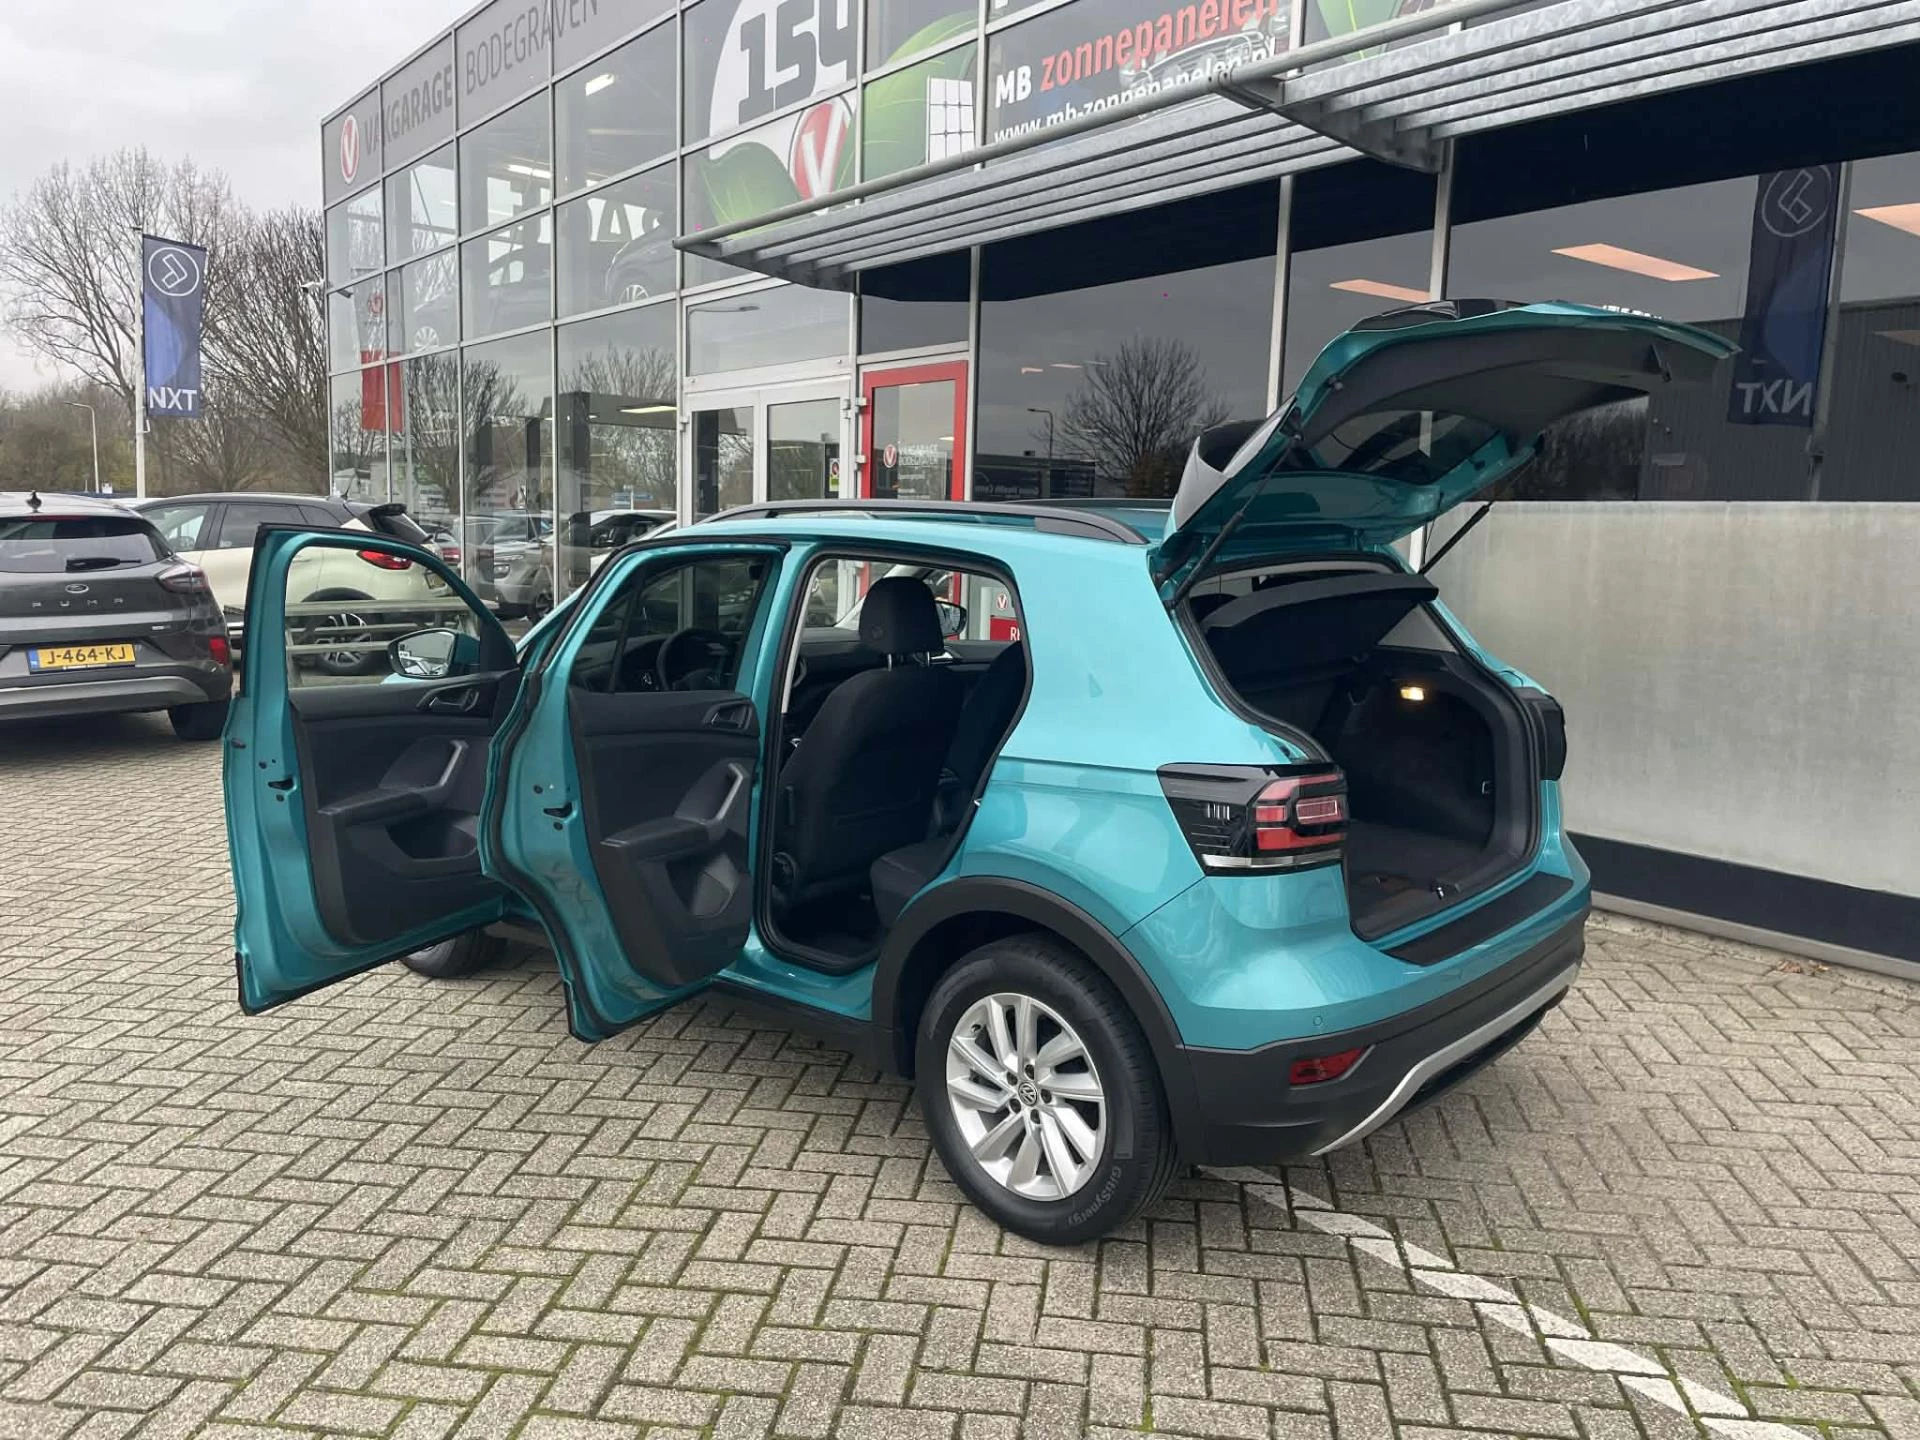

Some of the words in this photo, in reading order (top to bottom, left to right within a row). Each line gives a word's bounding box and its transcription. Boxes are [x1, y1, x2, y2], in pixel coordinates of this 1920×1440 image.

[994, 35, 1276, 143] wwwmb-zonnepanelennl
[995, 65, 1032, 109] MB
[150, 387, 198, 411] NXT
[47, 646, 127, 665] J-464-KJ
